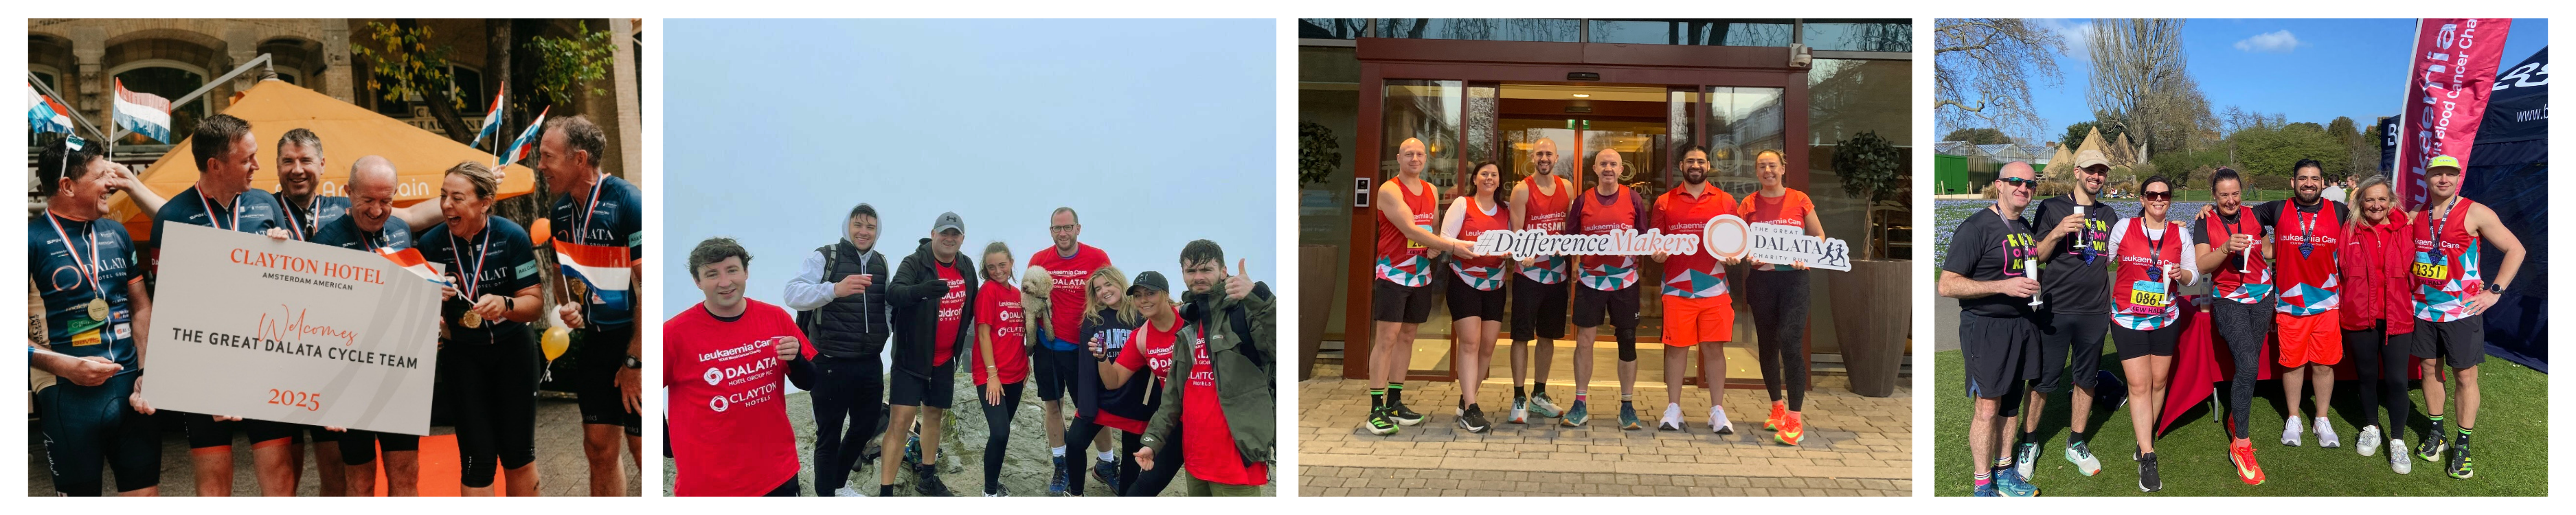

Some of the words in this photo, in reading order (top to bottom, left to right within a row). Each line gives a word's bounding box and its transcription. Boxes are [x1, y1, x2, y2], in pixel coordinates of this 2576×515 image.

[2435, 100, 2456, 139] Blood
[2447, 52, 2469, 99] Cancer
[2459, 19, 2477, 49] Cha
[2413, 23, 2457, 204] ukaemia
[1531, 211, 1560, 220] Leukaemia
[1787, 218, 1802, 226] Care
[1585, 223, 1620, 231] Leukaemia
[2085, 218, 2107, 232] UN
[2094, 231, 2106, 240] MY
[2322, 236, 2337, 244] Care
[1476, 231, 1695, 258] #DifferenceMakers
[1754, 234, 1824, 255] DALATA
[2441, 240, 2460, 249] Care
[1753, 253, 1788, 261] CHARITY
[230, 247, 319, 275] CLAYTON
[324, 261, 385, 286] HOTEL
[2417, 263, 2441, 278] 2351
[262, 272, 312, 285] AMSTERDAM
[313, 279, 353, 290] AMERICAN
[938, 308, 962, 317] aldron
[258, 304, 358, 346] Welcomes
[74, 336, 100, 345] savills
[173, 327, 203, 343] THE
[209, 332, 260, 351] GREAT
[264, 339, 322, 358] DALATA
[328, 347, 374, 365] CYCLE
[380, 353, 418, 369] TEAM
[699, 343, 754, 362] Leukaemia
[754, 339, 771, 349] Car
[725, 356, 778, 379] DALATA
[729, 378, 746, 387] HOTEL
[747, 372, 765, 382] GROUP
[730, 380, 776, 403] CLAYTON
[268, 388, 321, 411] 2025
[745, 395, 771, 407] HOTELS
